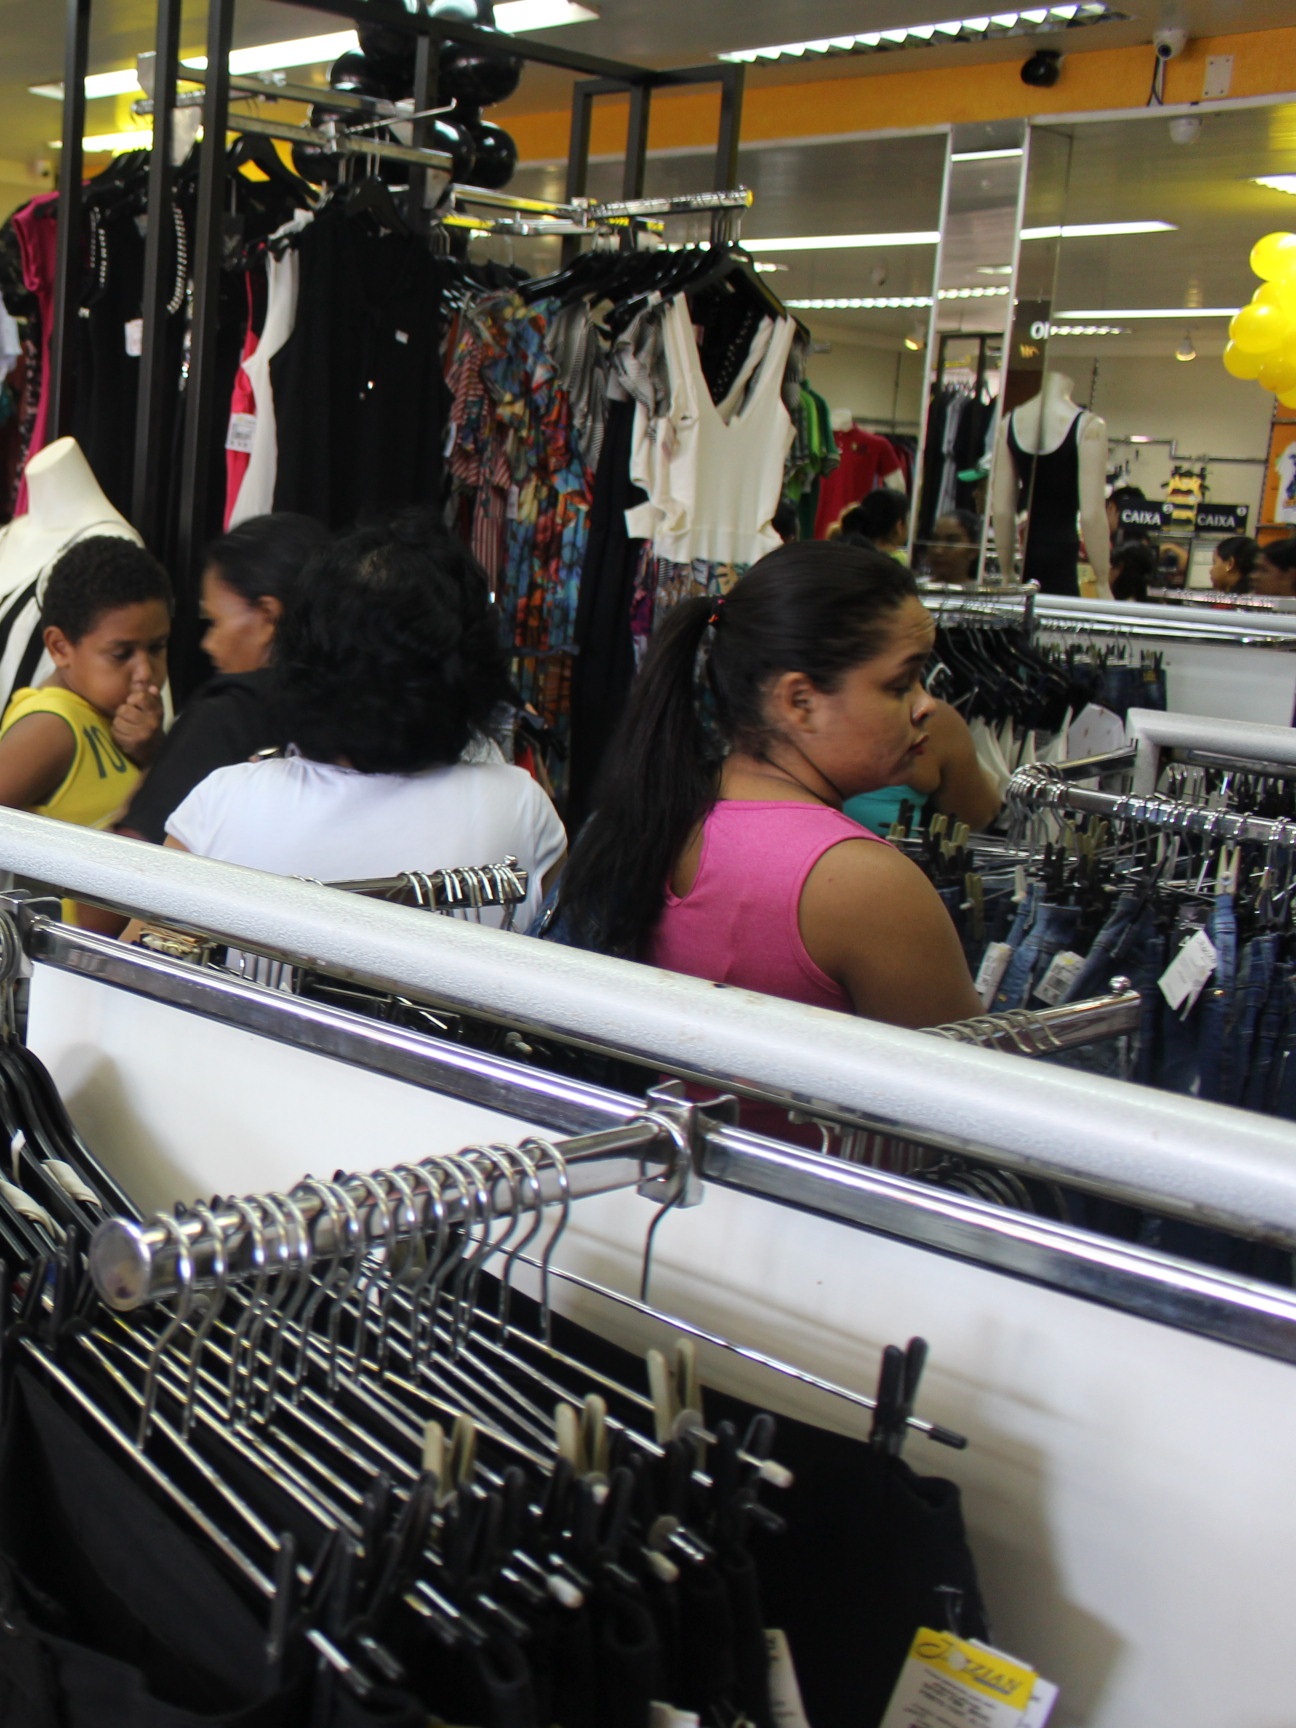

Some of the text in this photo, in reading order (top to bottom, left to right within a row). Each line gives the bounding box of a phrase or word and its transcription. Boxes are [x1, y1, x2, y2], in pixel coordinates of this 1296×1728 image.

[1121, 509, 1161, 526] CAIXA
[1197, 513, 1235, 528] CAIXA
[83, 725, 128, 780] 10
